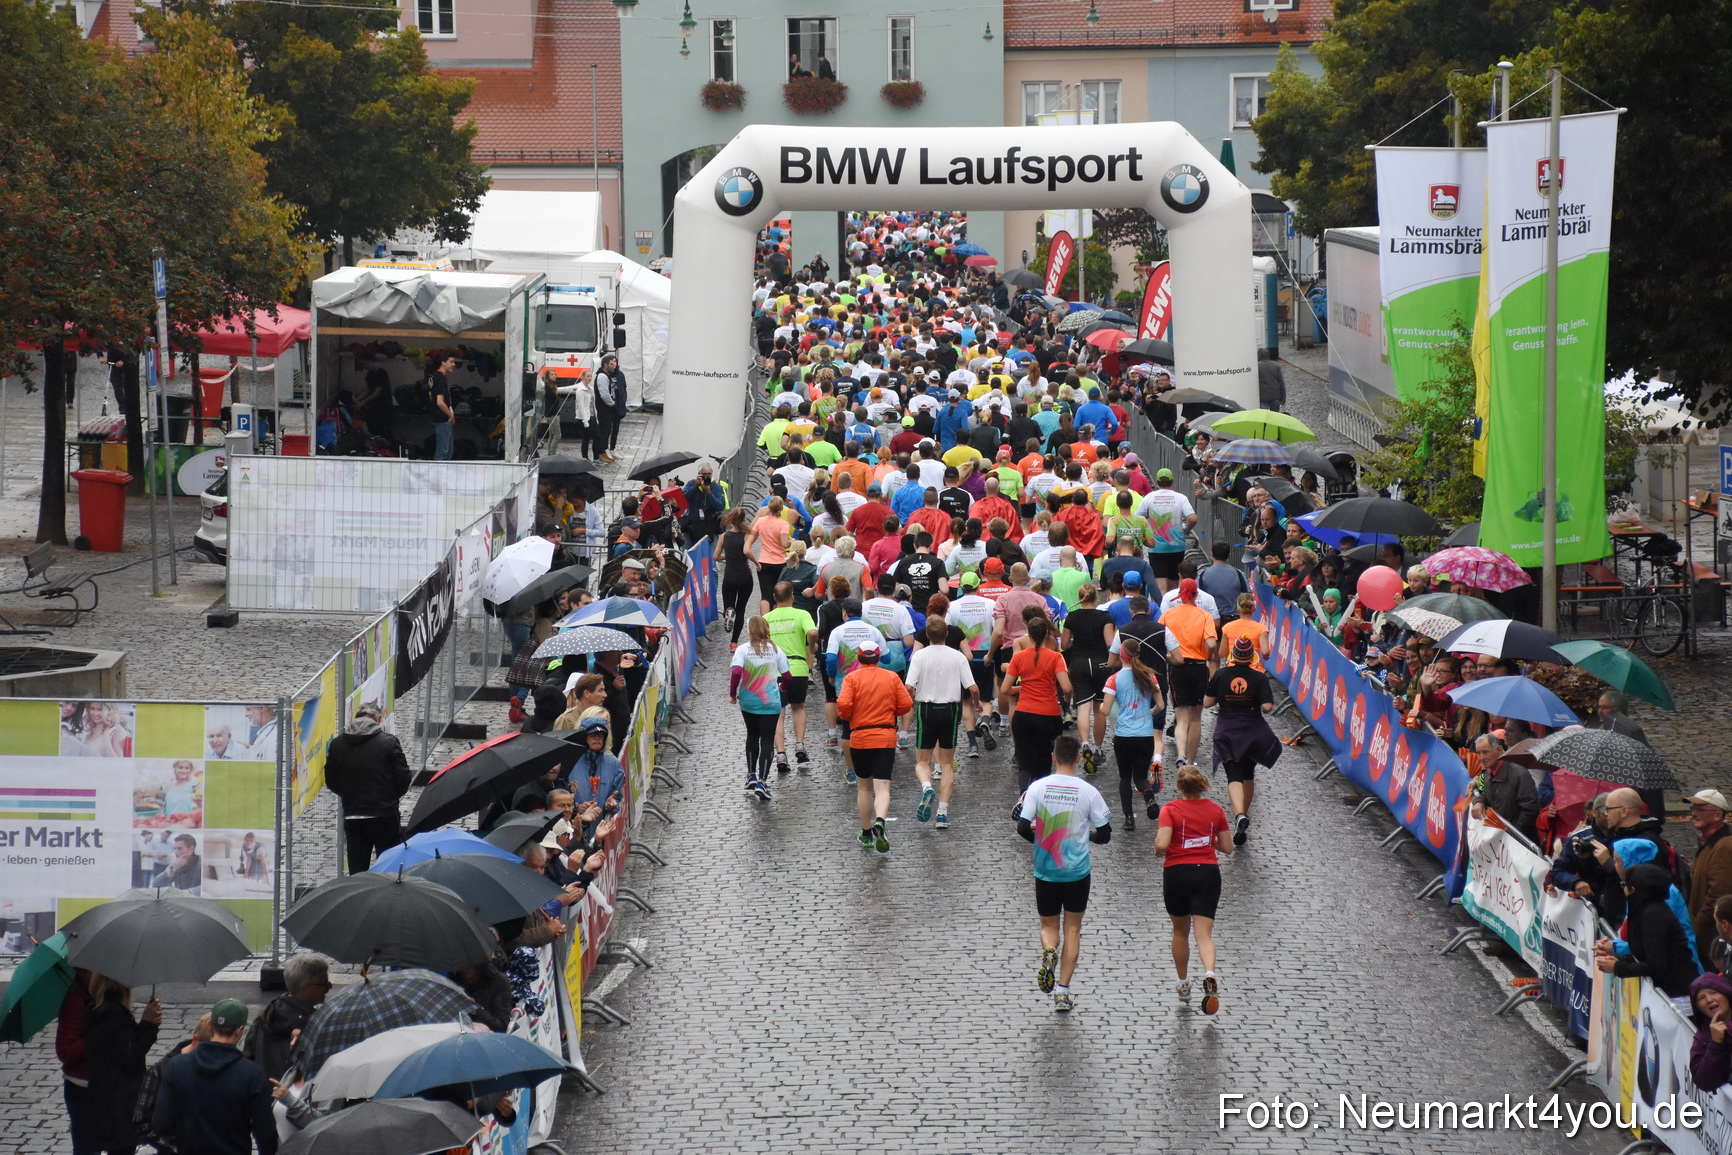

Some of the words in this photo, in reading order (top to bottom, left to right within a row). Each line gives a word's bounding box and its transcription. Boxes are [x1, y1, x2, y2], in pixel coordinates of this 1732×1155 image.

[719, 168, 758, 185] BMW
[780, 146, 906, 185] BMW
[919, 146, 1144, 192] Laufsport
[1166, 165, 1207, 182] BMW
[1515, 203, 1586, 221] Neumrkter
[1405, 225, 1483, 237] Neumarkter
[1390, 238, 1483, 254] Lammsbrä
[1045, 239, 1070, 296] REWE
[1398, 338, 1432, 349] Genuss
[1513, 340, 1545, 351] Genuss
[672, 369, 740, 379] www.bmw-laufsport.de
[240, 416, 248, 430] P
[867, 610, 894, 618] NeuerMarkt
[24, 826, 104, 848] Markt
[7, 854, 38, 865] leben
[44, 855, 95, 867] genießen
